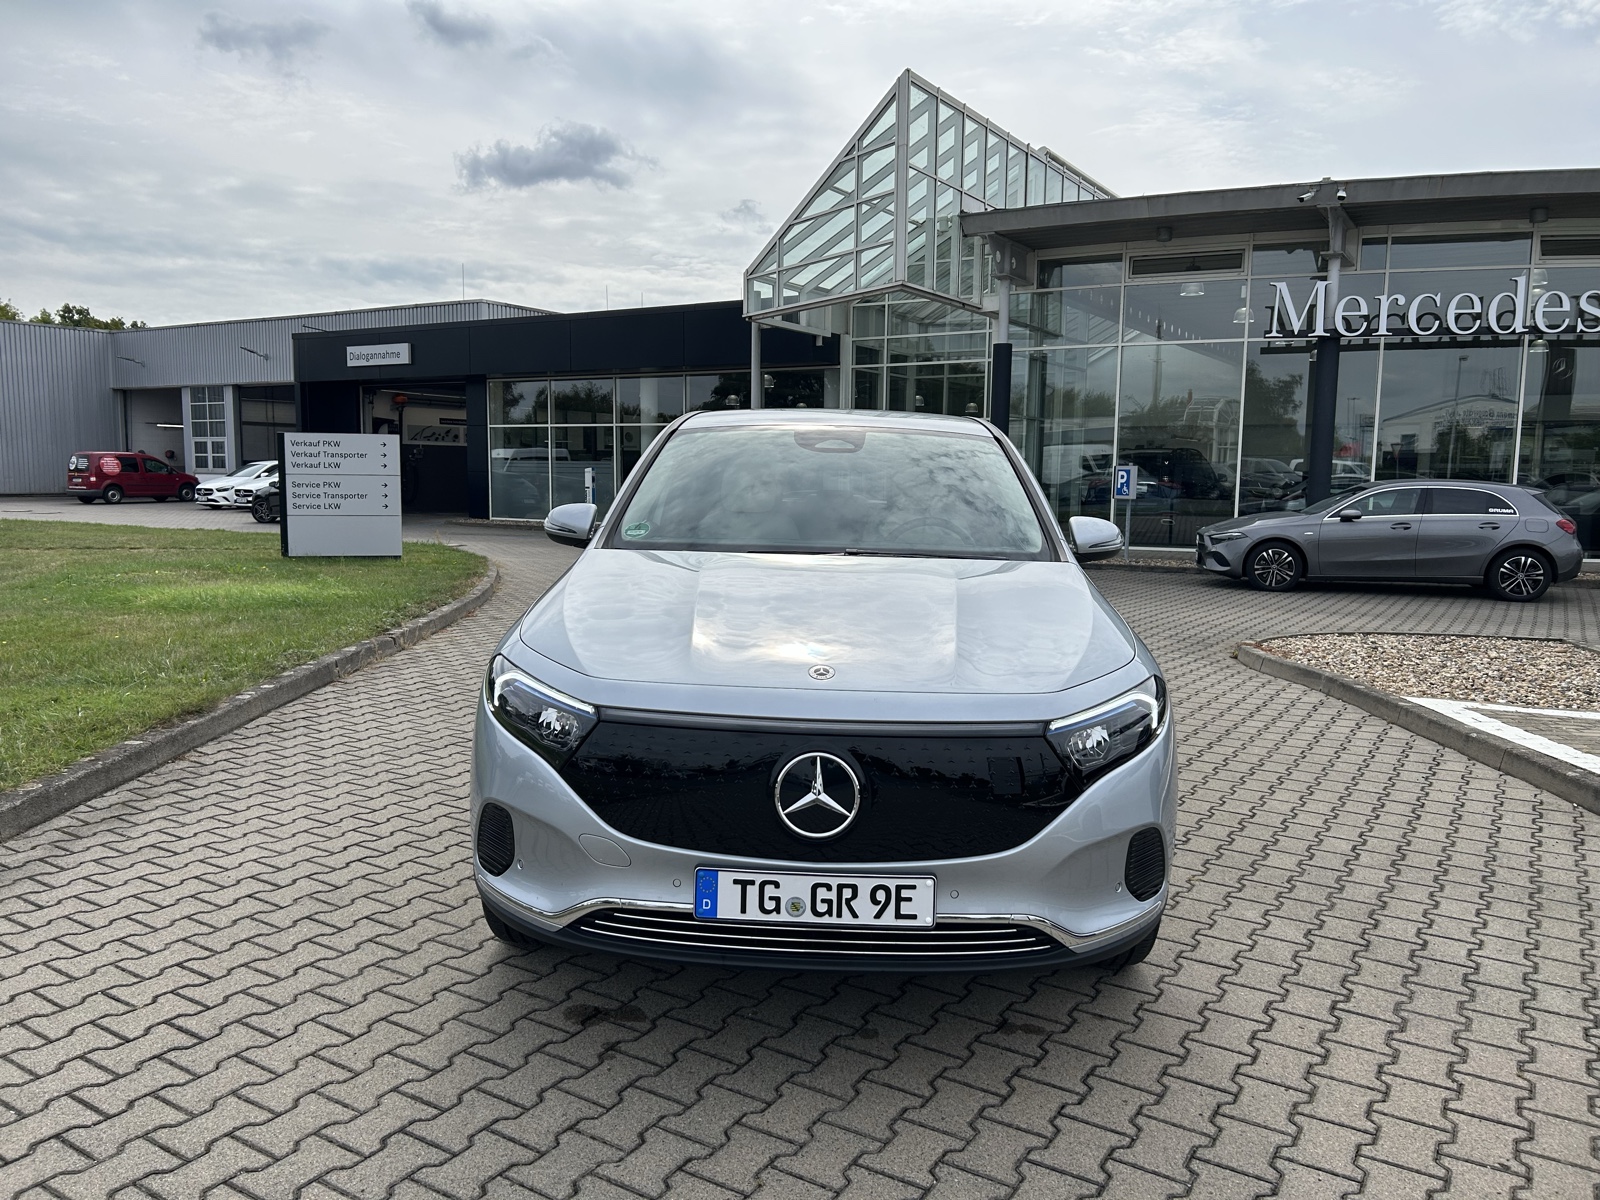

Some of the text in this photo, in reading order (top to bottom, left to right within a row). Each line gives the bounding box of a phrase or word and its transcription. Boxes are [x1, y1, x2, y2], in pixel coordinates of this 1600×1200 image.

[1265, 275, 1600, 337] Mercedes
[349, 350, 401, 362] Dialogannahme
[290, 450, 368, 460] Verkauf Transporter
[291, 461, 322, 469] Verkauf
[1118, 471, 1128, 488] P
[291, 491, 368, 501] Service Transporter
[292, 502, 322, 510] Service
[702, 898, 711, 910] D
[732, 878, 918, 920] TG GR 9E
